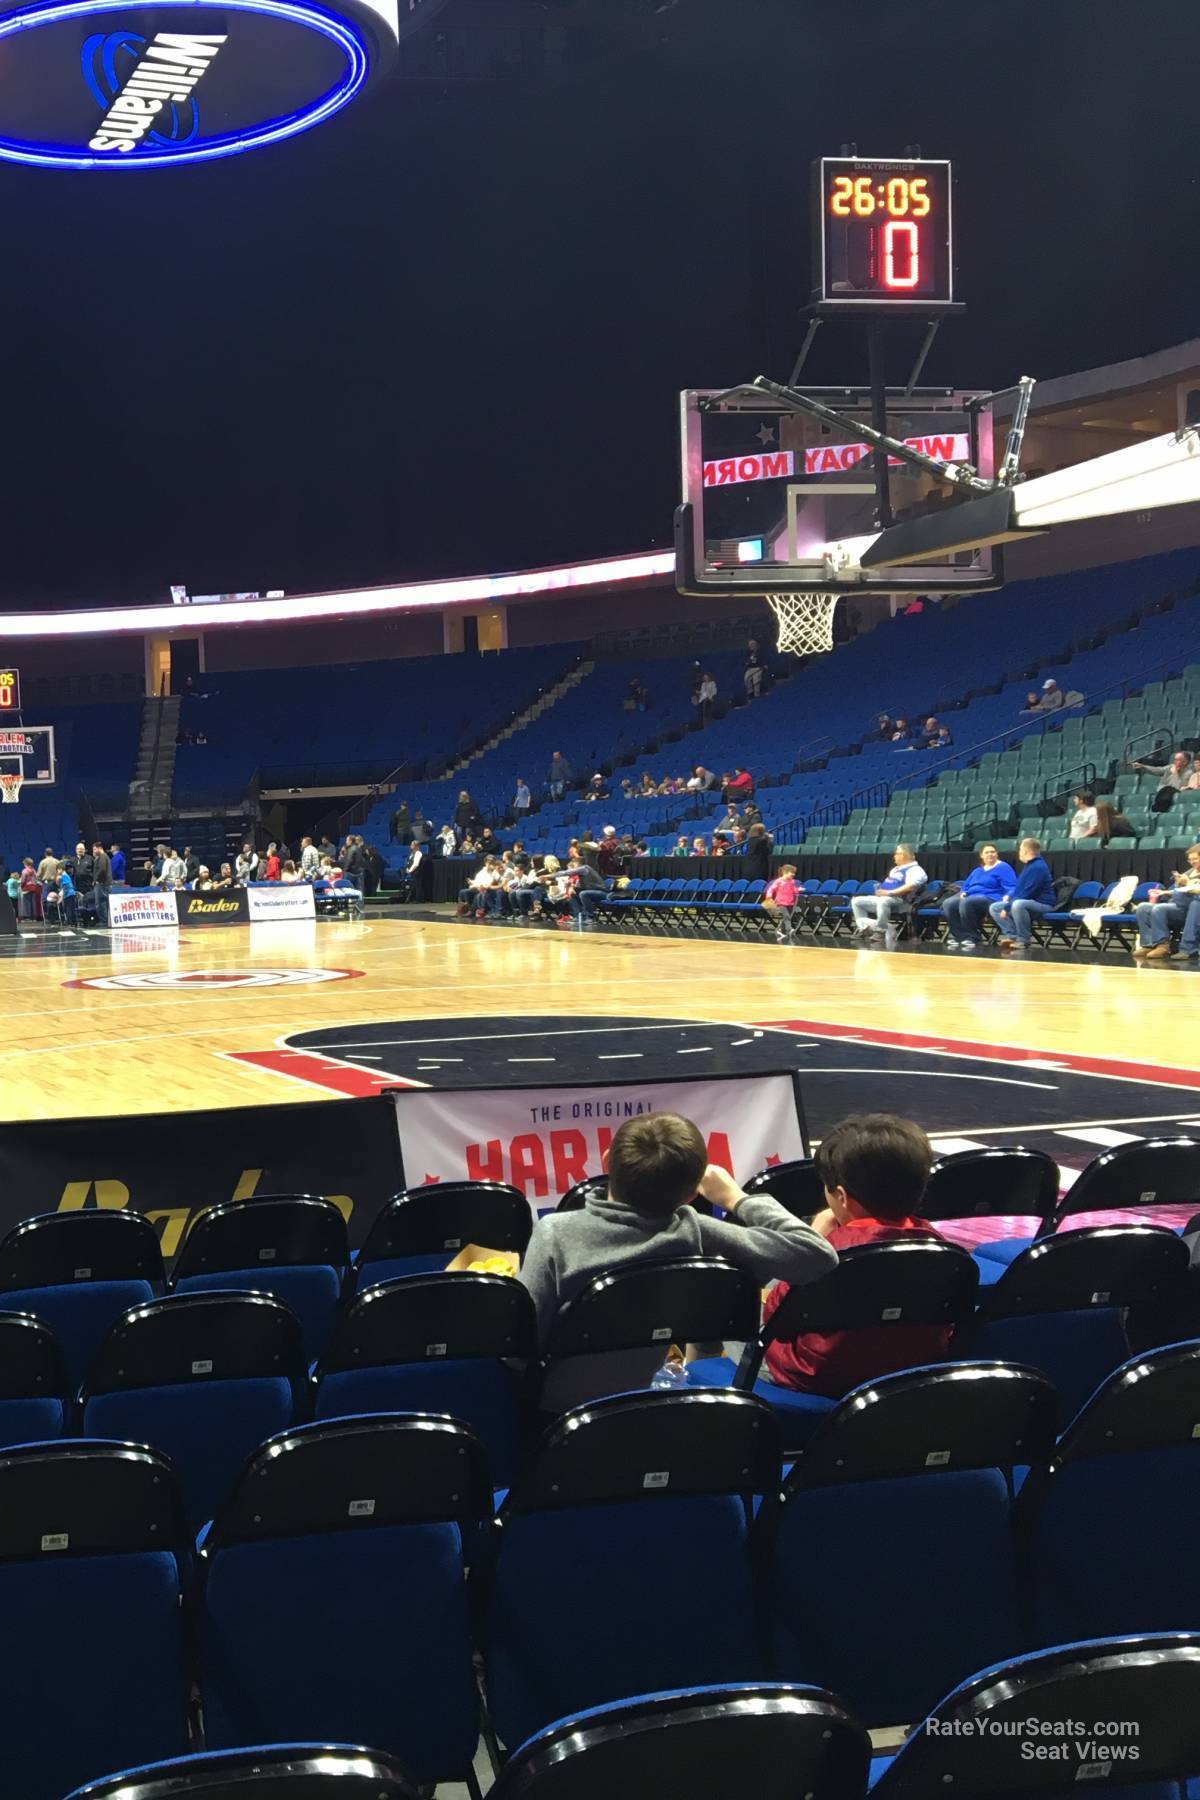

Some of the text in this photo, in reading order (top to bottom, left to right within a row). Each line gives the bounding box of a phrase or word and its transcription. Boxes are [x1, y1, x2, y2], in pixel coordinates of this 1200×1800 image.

[89, 33, 228, 152] Williams
[854, 163, 915, 171] DAKTRONICS
[831, 176, 930, 215] 26:05
[884, 221, 919, 287] 0
[120, 899, 165, 913] HARLEM
[187, 898, 240, 913] Baden
[113, 911, 175, 924] GLOBETROTTERS
[531, 1105, 563, 1124] THE
